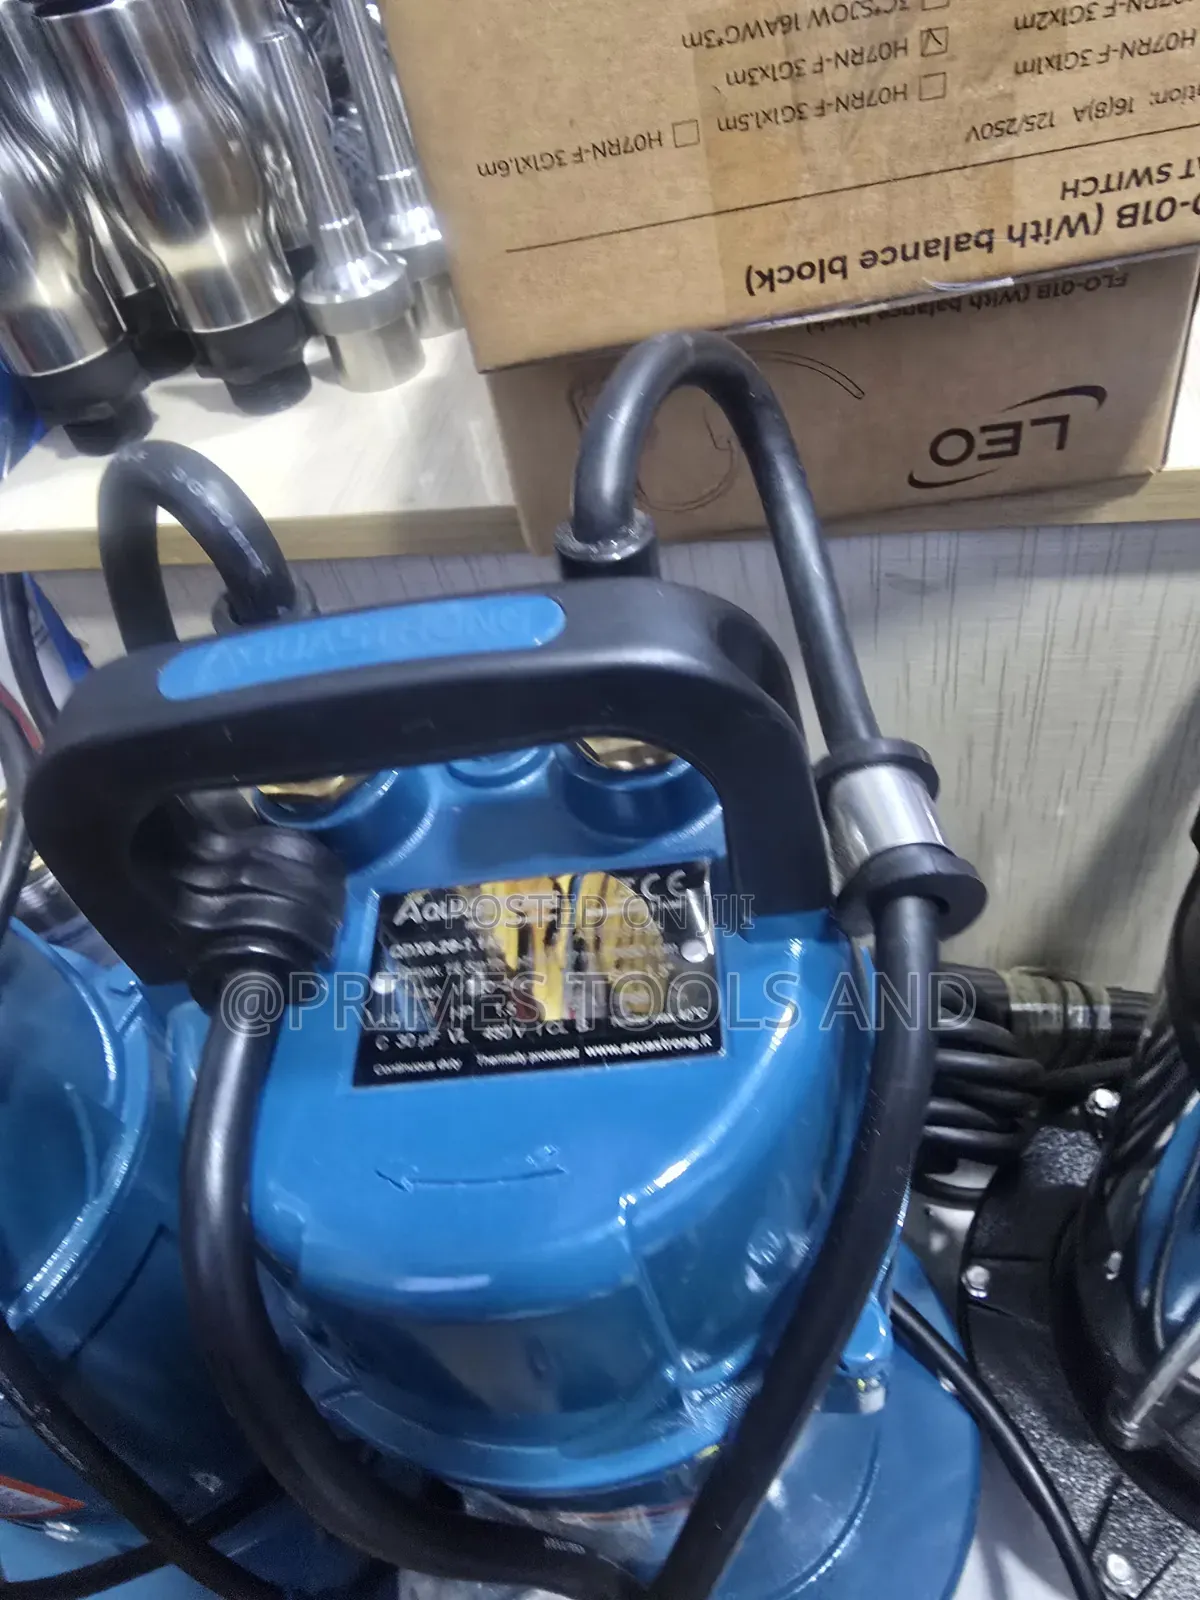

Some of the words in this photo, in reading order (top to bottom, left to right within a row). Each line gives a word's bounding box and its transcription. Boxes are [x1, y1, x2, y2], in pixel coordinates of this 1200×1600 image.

[813, 38, 909, 74] H07RN-F
[1014, 48, 1093, 75] 3G1x1m
[1097, 28, 1196, 65] H07RN-F
[725, 58, 806, 86] 3G1x3m
[814, 83, 909, 118] H07RN-F
[1072, 96, 1134, 123] 16(8)A
[1150, 84, 1200, 106] tion:
[717, 101, 808, 132] 3G1x1.5m
[964, 110, 1056, 143] 125/250V
[477, 149, 568, 177] 3G1x1.6m
[572, 130, 664, 164] H07RN-F
[1060, 162, 1173, 201] SWITCH
[1177, 157, 1200, 180] T
[1008, 202, 1104, 248] (With
[859, 229, 995, 269] balance
[745, 255, 848, 296] block)
[929, 414, 1070, 467] LEO
